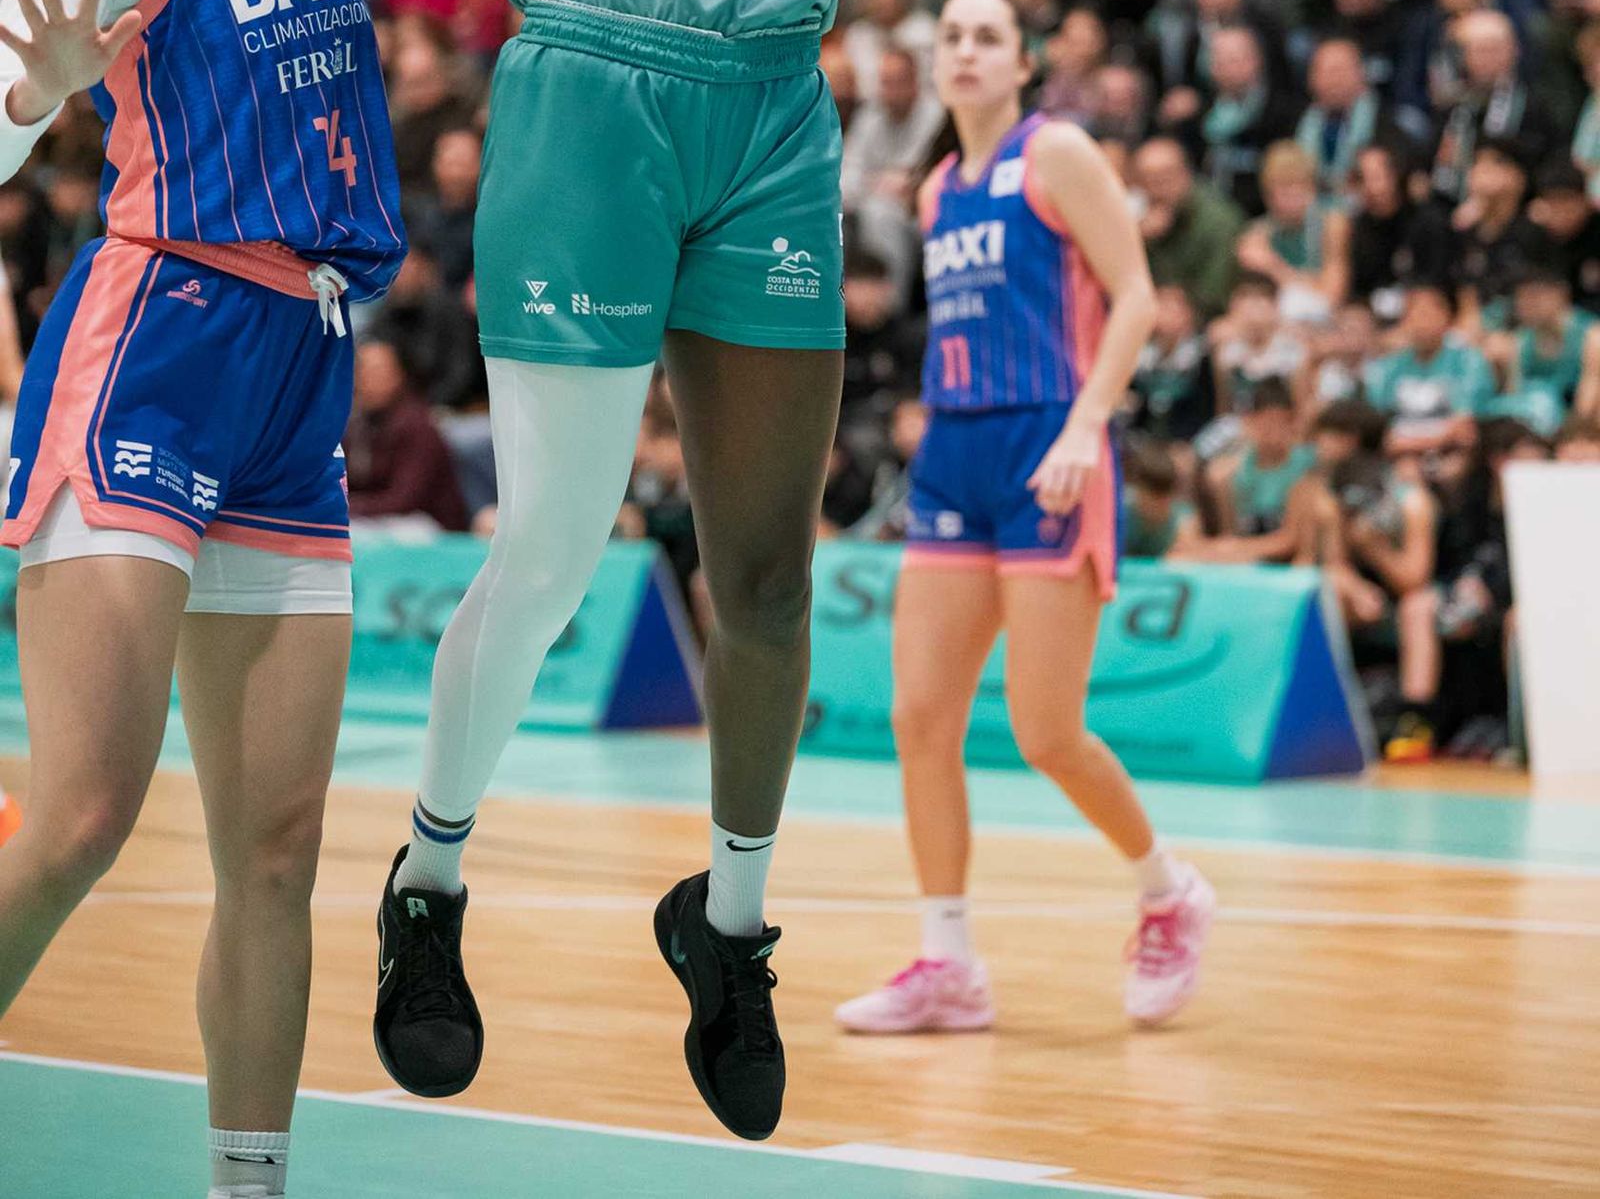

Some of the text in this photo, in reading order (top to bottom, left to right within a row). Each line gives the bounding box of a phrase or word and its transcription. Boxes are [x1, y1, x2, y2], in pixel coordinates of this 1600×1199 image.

[767, 276, 820, 287] COSTA DEL SOL
[766, 284, 820, 295] OCCIDENTAL
[522, 300, 556, 315] vive
[592, 302, 653, 318] Hospiten
